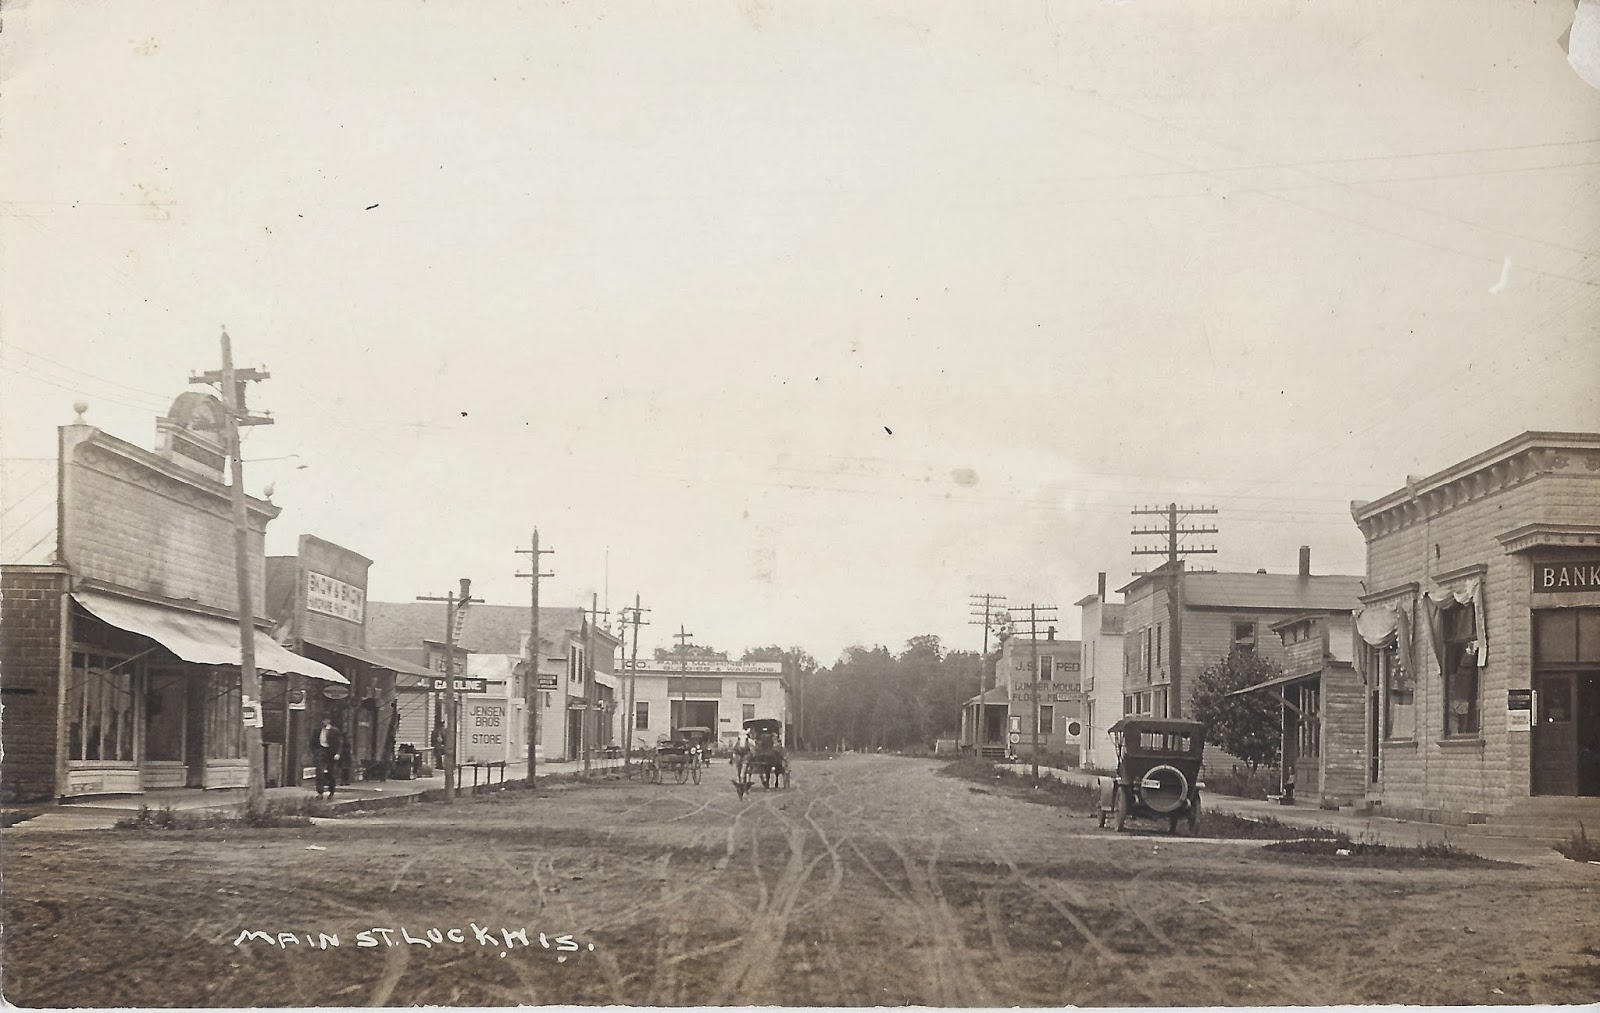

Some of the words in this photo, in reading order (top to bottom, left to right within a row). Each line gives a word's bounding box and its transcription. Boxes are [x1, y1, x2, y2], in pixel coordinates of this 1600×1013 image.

[1543, 566, 1600, 588] BANK
[434, 679, 482, 691] GAOLINE
[469, 706, 505, 718] JENSEN
[475, 716, 500, 727] BROS
[471, 734, 502, 745] STORE
